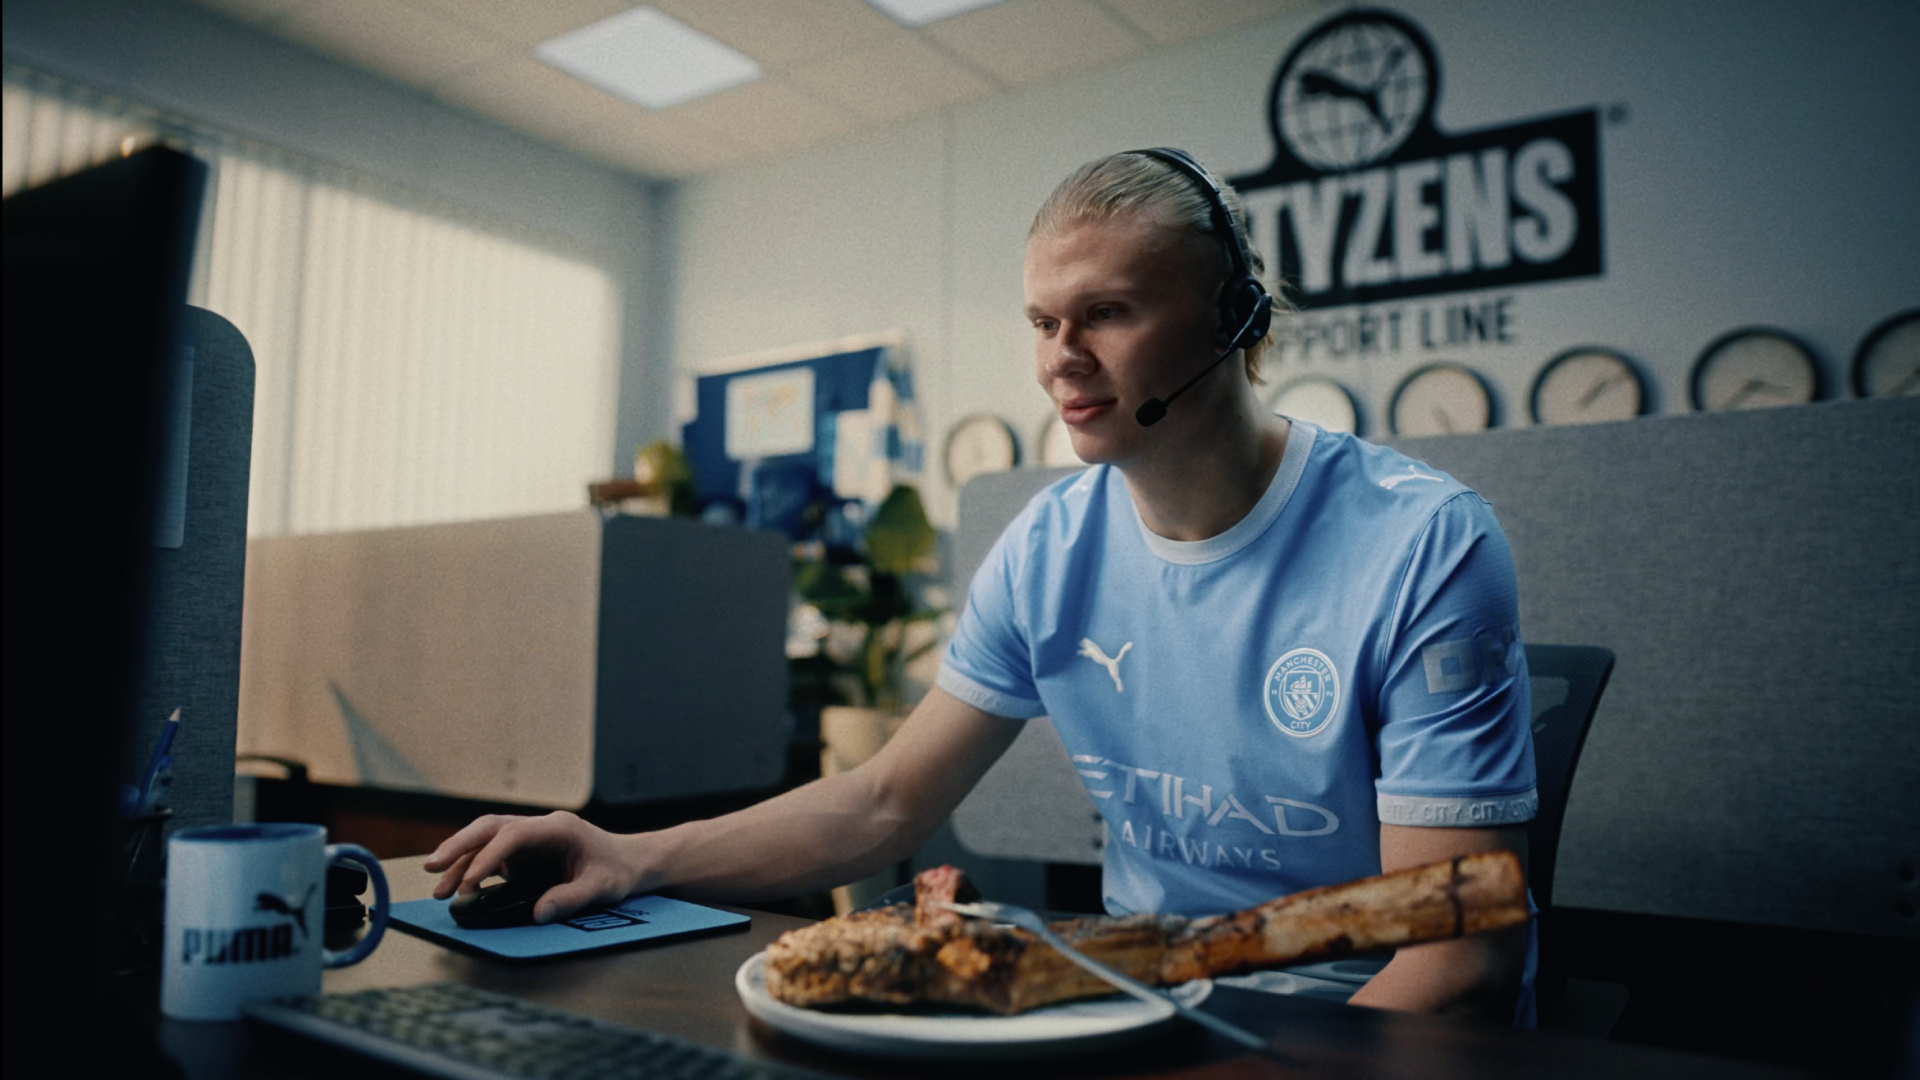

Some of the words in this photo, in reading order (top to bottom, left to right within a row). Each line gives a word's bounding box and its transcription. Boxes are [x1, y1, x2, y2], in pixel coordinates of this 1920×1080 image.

[1242, 139, 1576, 292] TYZENS
[1278, 304, 1402, 360] PPORT
[1420, 298, 1514, 348] LINE
[1274, 656, 1331, 682] MANCHESTER
[1290, 721, 1311, 729] CITY
[1073, 754, 1340, 836] ETIHAD
[1422, 803, 1463, 821] CITY
[1469, 801, 1505, 820] CITY
[1121, 820, 1281, 870] AIRWAYS
[183, 924, 293, 963] PUMA
